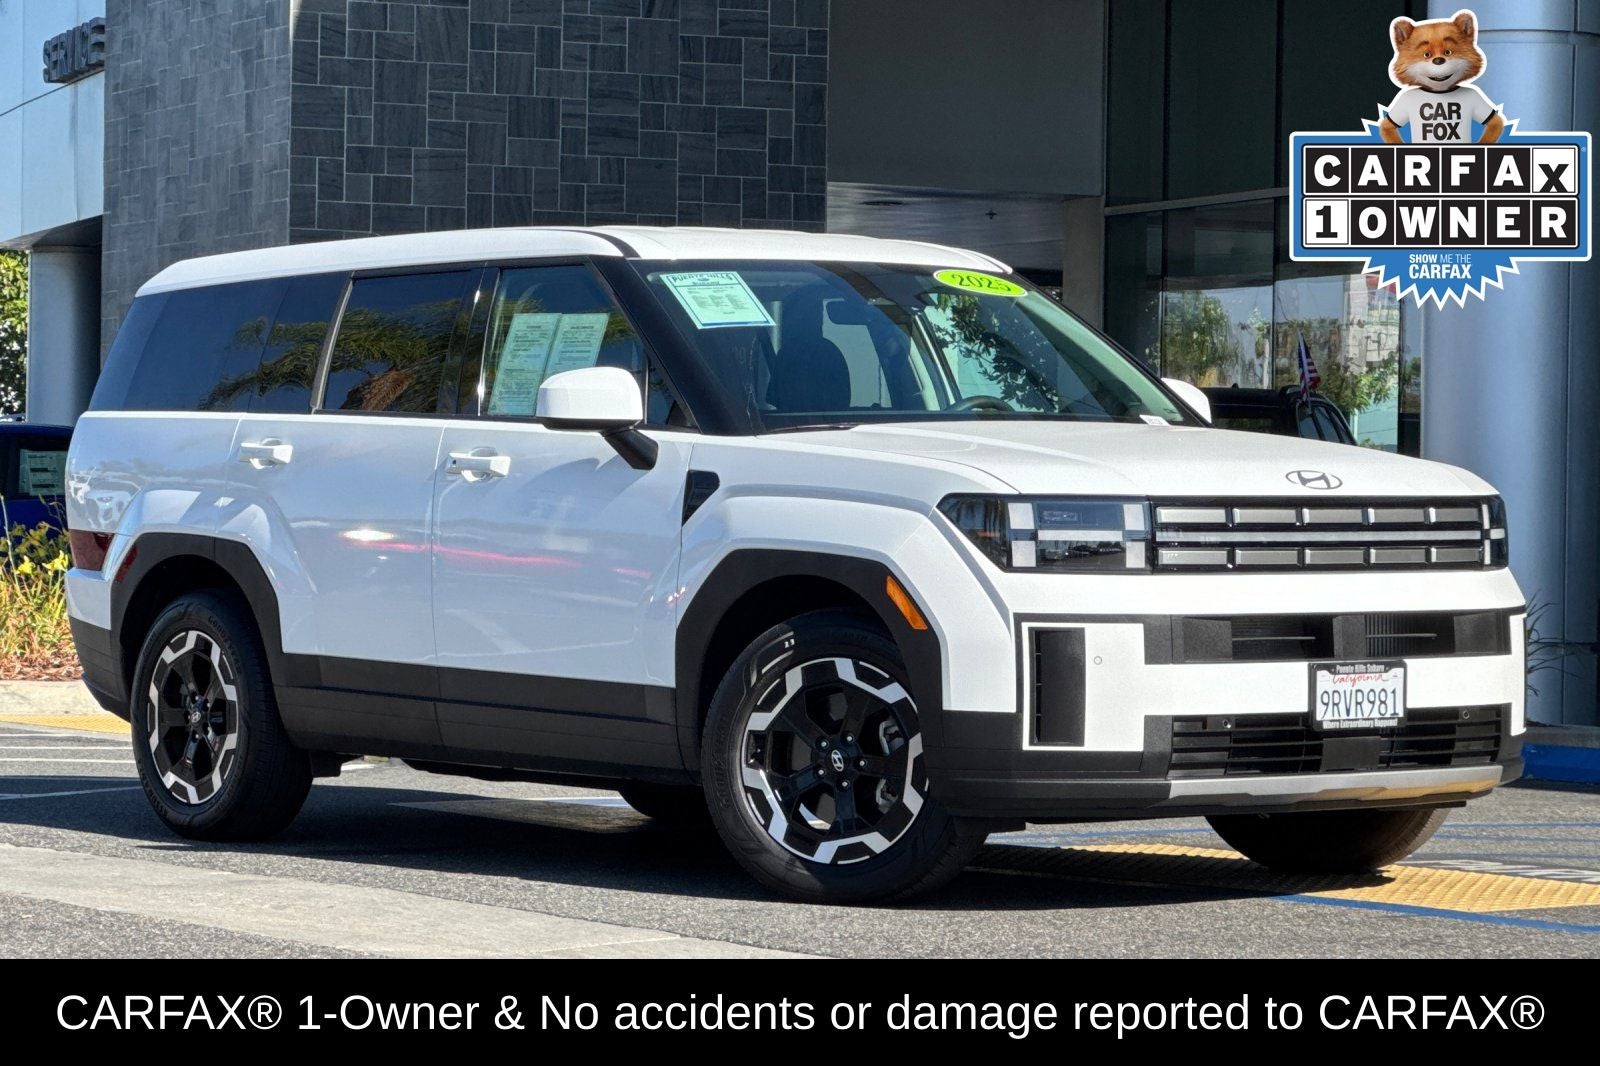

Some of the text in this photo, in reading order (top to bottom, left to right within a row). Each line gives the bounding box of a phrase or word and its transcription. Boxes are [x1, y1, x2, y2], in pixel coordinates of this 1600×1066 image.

[951, 274, 1012, 292] 2025
[1332, 672, 1384, 687] California
[1320, 687, 1399, 719] 9RVR981
